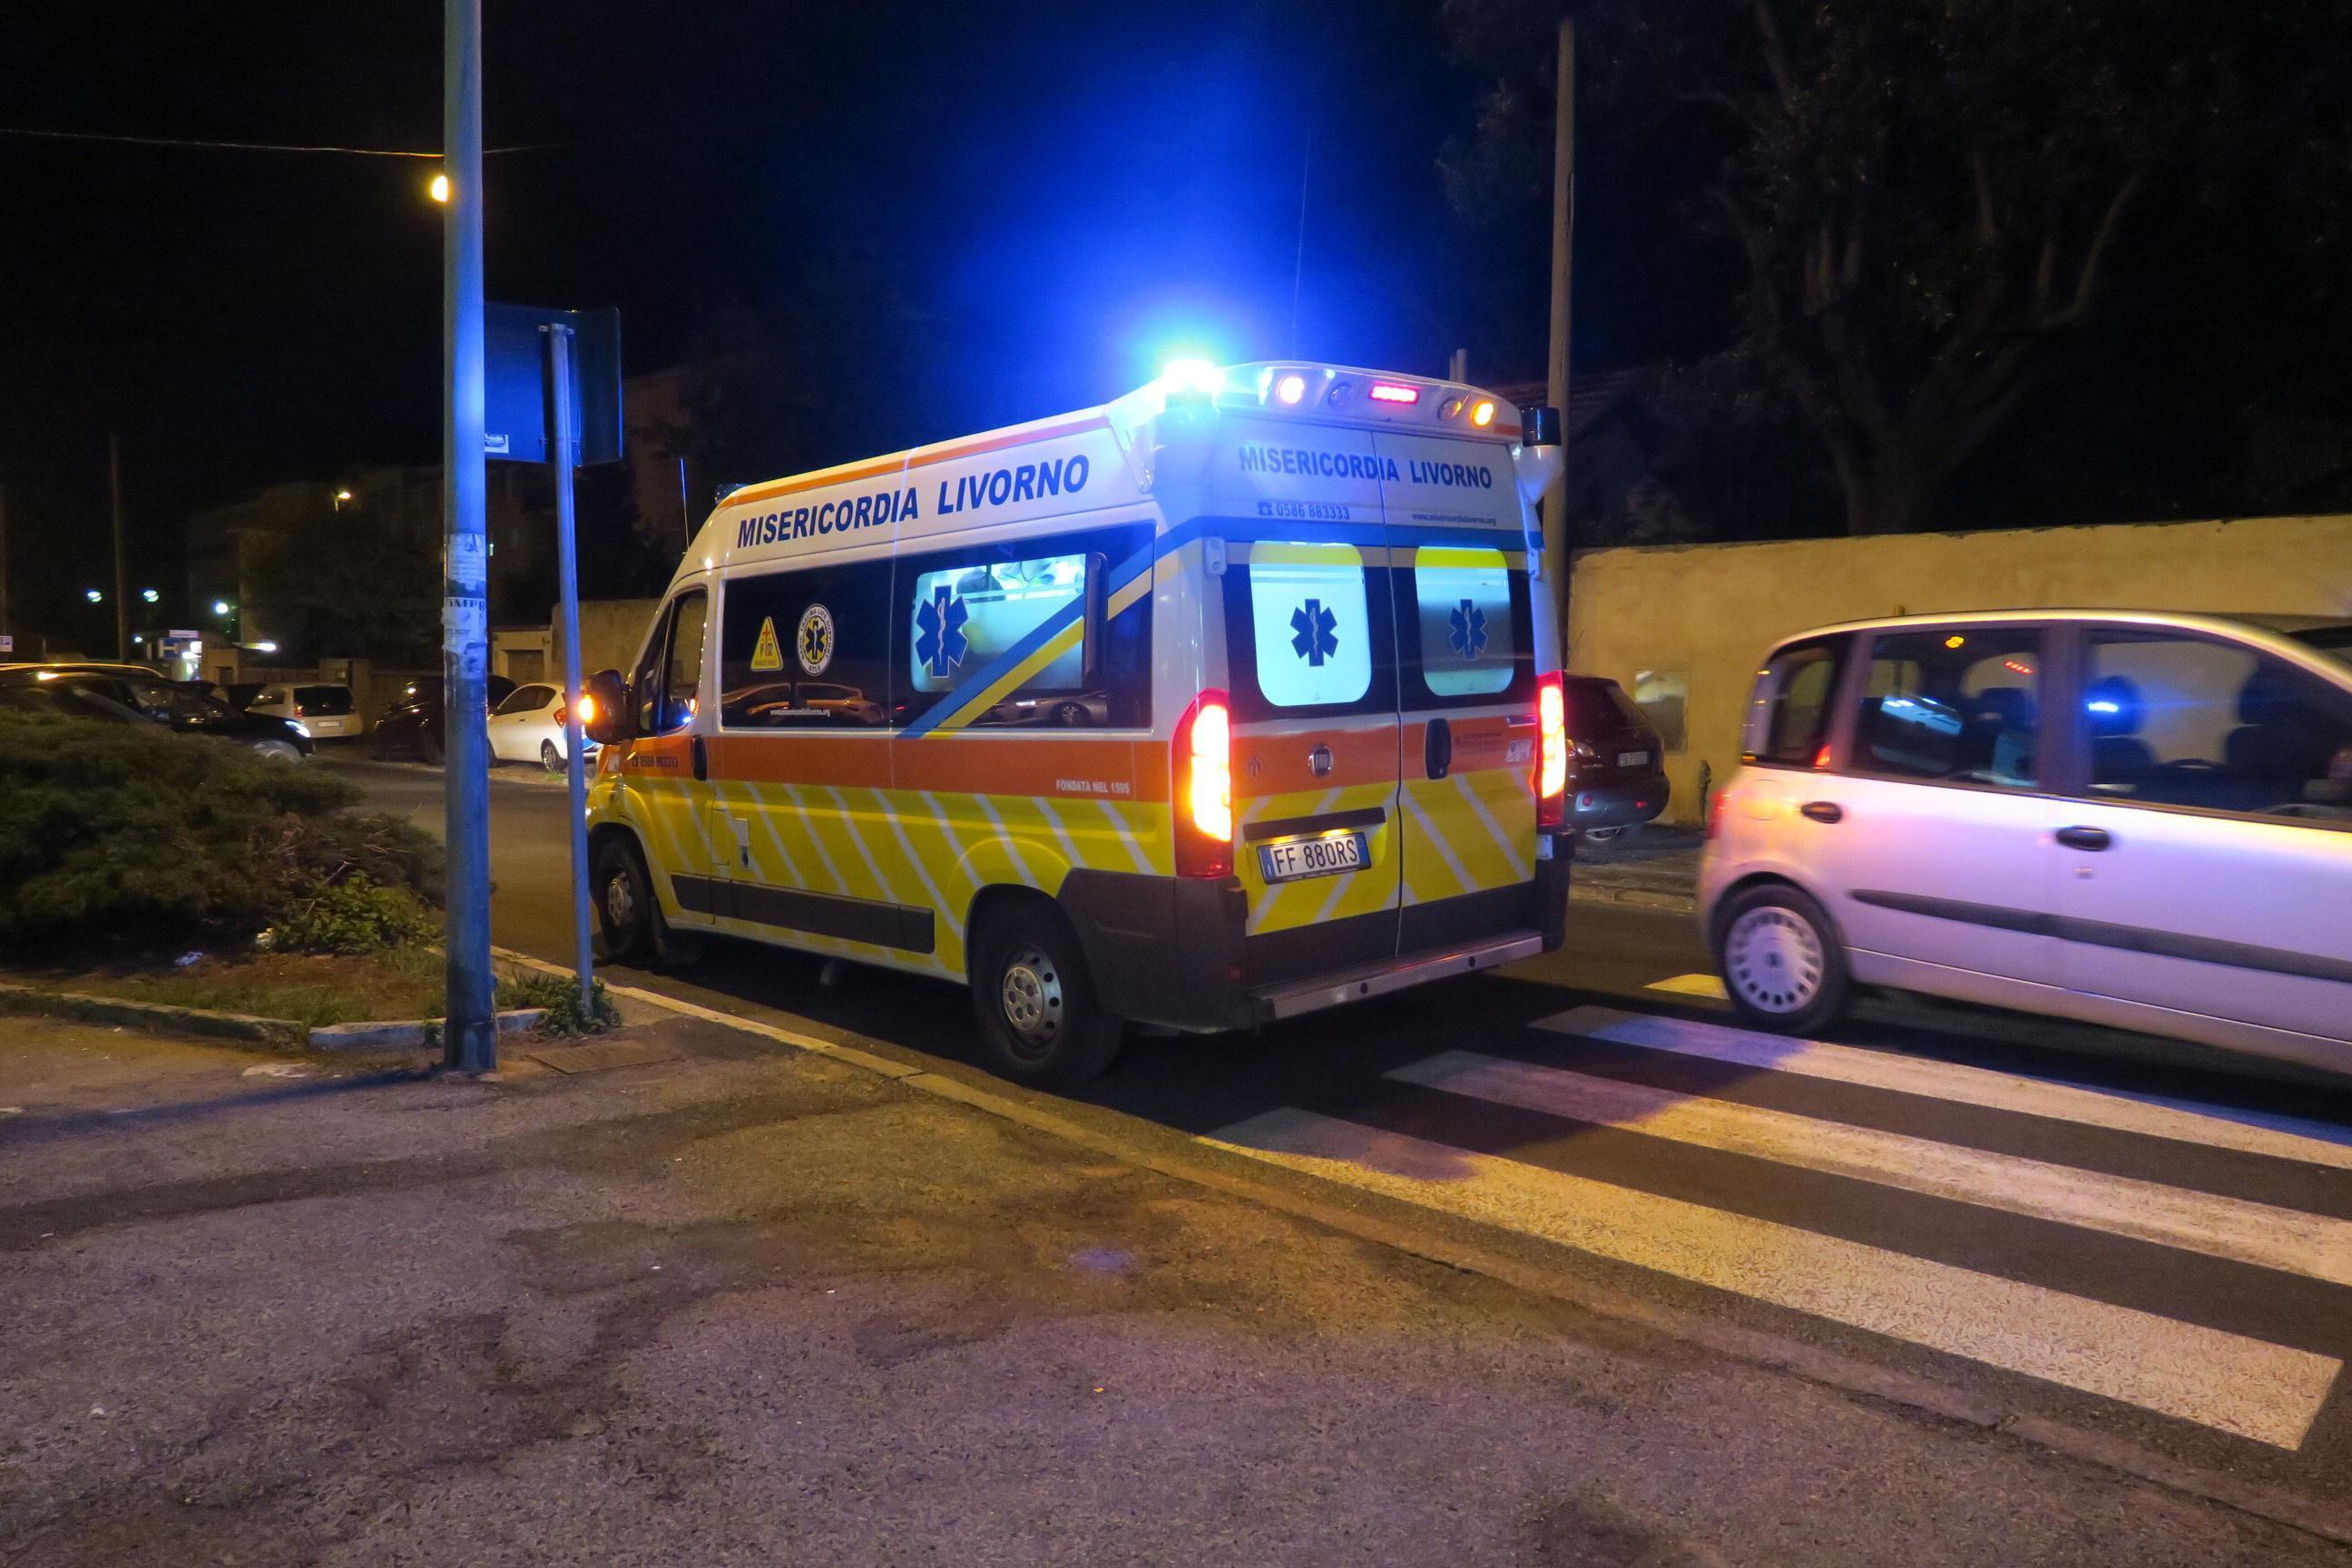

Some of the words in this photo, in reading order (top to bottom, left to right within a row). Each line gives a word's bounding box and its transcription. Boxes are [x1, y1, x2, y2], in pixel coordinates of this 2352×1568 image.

[1240, 446, 1400, 482] MISERICORDIA
[1409, 460, 1492, 489] LIVORNO
[737, 487, 918, 549] MISERICORDIA
[936, 455, 1089, 515] LIVORNO
[1276, 502, 1305, 517] 0586
[1308, 503, 1350, 520] 883333
[1055, 779, 1092, 792] FONDATA
[1093, 781, 1109, 793] NEL
[1273, 847, 1296, 874] FF
[1303, 839, 1357, 868] 880RS
